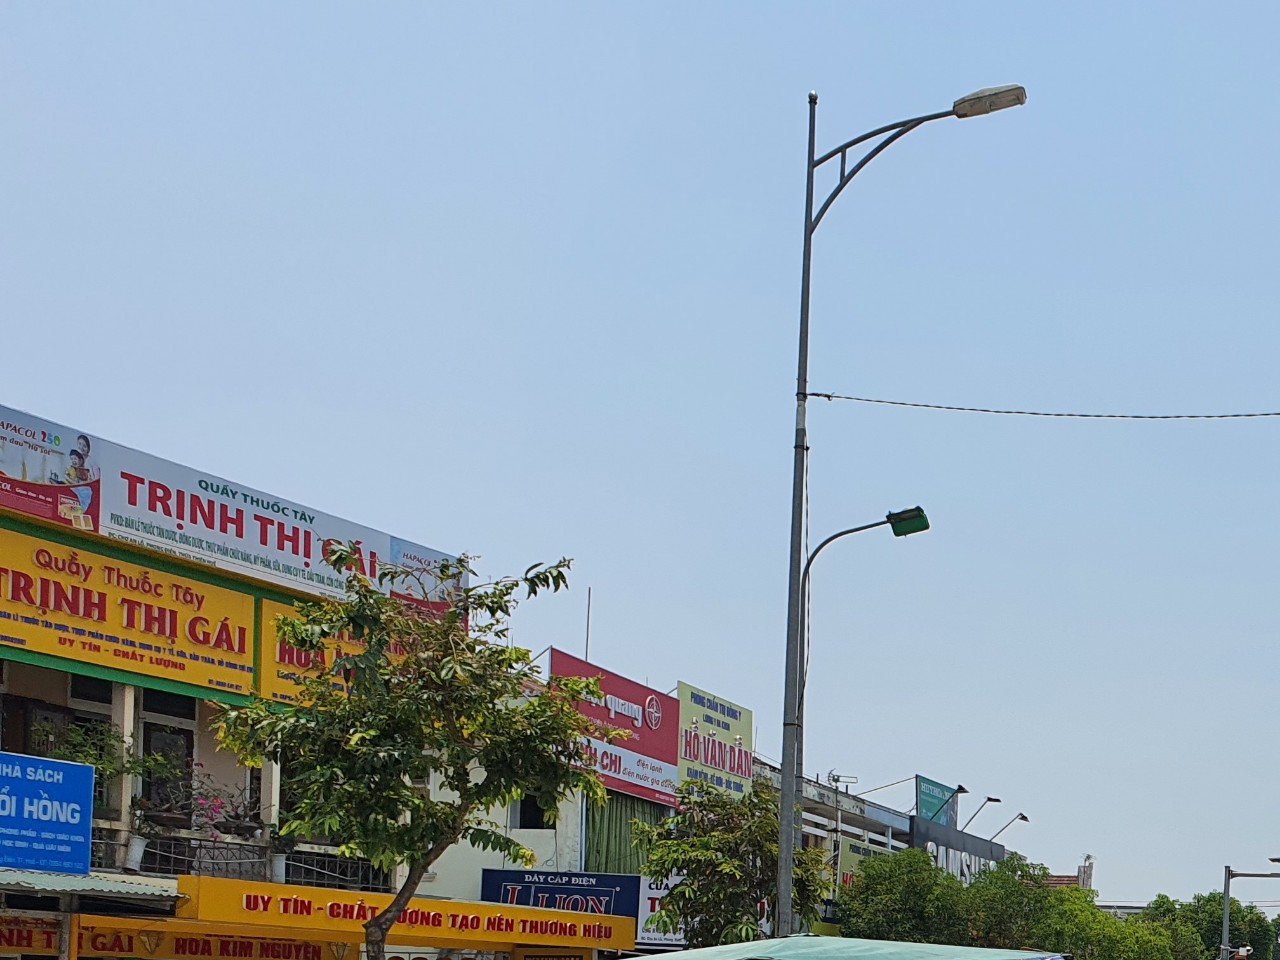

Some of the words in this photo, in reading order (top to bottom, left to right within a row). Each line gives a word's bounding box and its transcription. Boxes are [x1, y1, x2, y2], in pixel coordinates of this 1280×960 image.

[41, 430, 61, 447] 250
[241, 492, 289, 517] THUỐC
[292, 509, 315, 524] TÂY
[120, 471, 244, 540] TRỊNH
[253, 513, 312, 568] THỊ
[322, 538, 377, 580] GÁI
[103, 563, 163, 598] Thuốc
[171, 583, 204, 611] Tây
[118, 597, 178, 645] THỊ
[185, 616, 247, 655] GÁI
[58, 636, 75, 647] UY
[81, 641, 101, 652] TÍN
[150, 656, 185, 671] LƯỢNG
[606, 695, 643, 728] quang
[601, 751, 622, 774] CHI
[701, 729, 727, 770] VĂN
[26, 766, 63, 784] SÁCH
[24, 790, 81, 824] HỒNG
[525, 874, 546, 883] DÂY
[571, 877, 597, 887] ĐIỆN
[925, 841, 998, 888] SAMSU
[242, 893, 272, 912] UY
[278, 895, 312, 916] TÍN
[394, 907, 442, 929] ƯỢNG
[448, 912, 481, 932] TẠO
[484, 914, 515, 932] NÊN
[519, 919, 577, 937] THƯƠNG
[581, 922, 613, 942] HIỆU
[91, 931, 134, 953] GÁI
[175, 938, 212, 956] HOA
[219, 939, 253, 958] KIM
